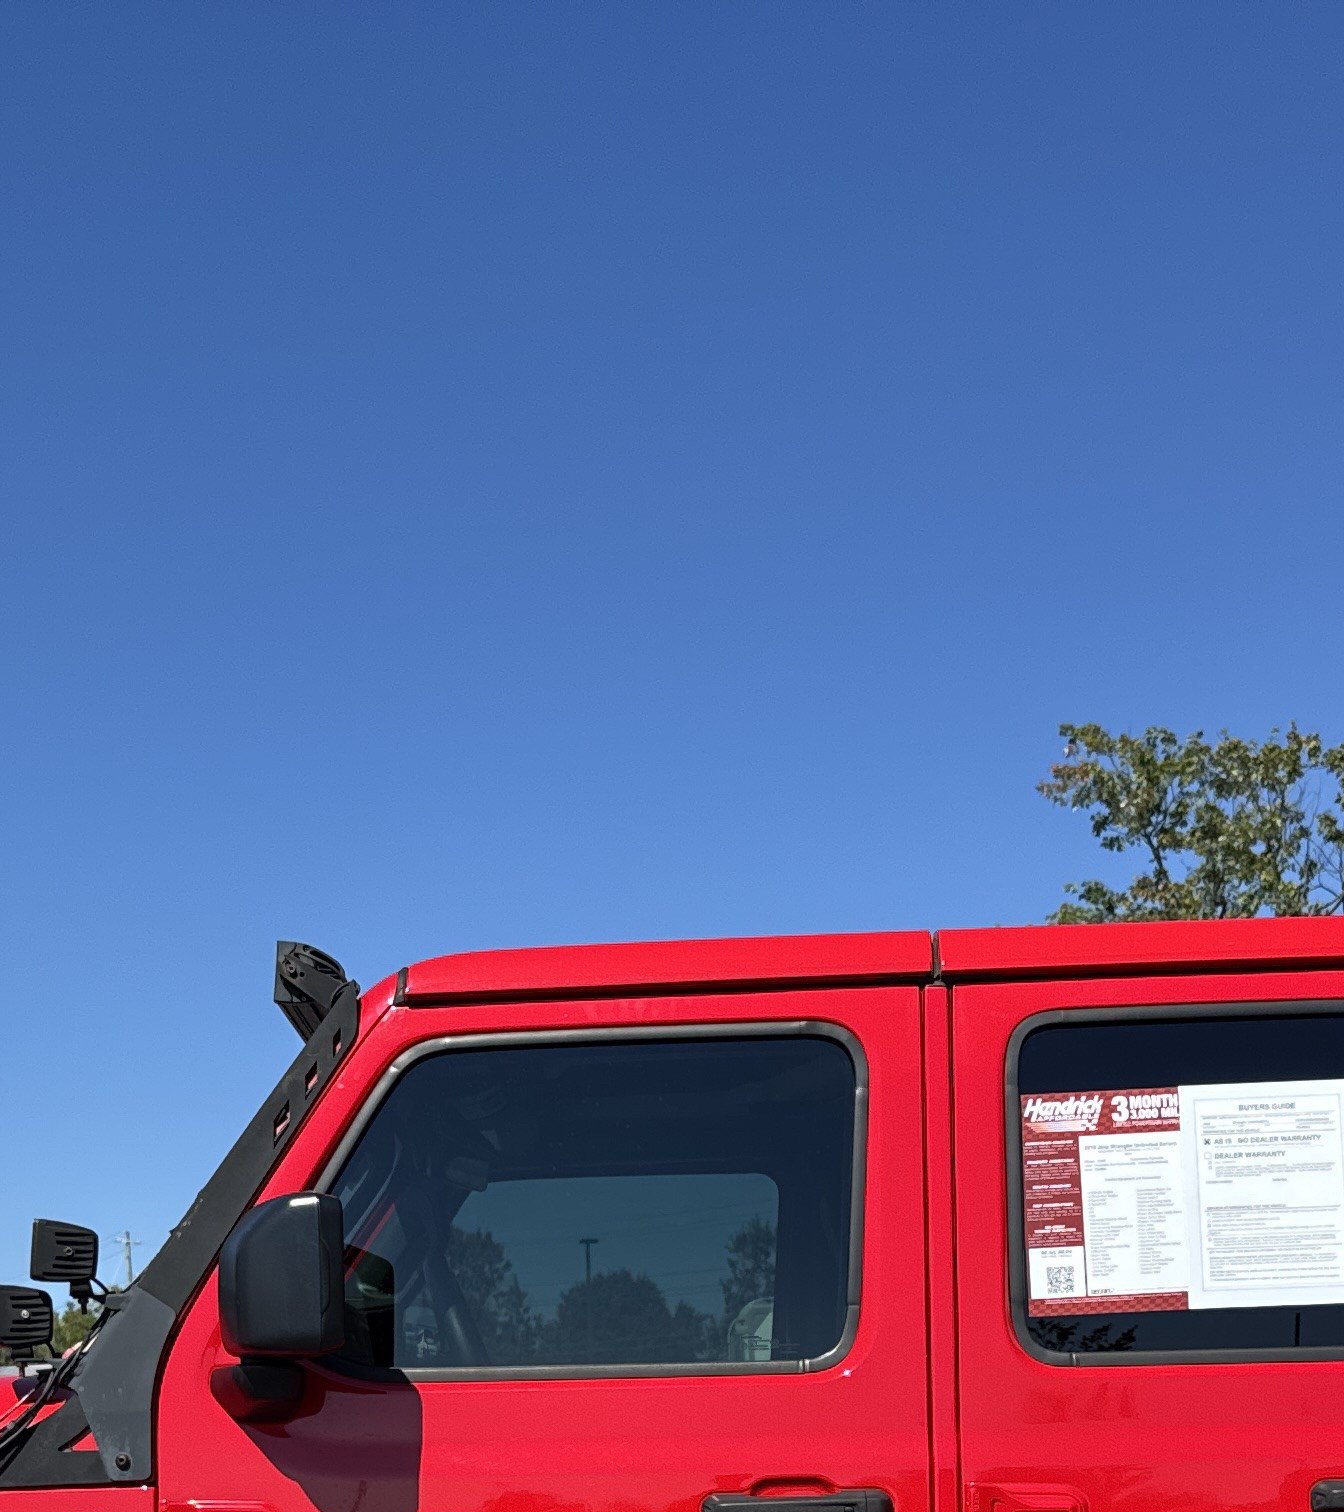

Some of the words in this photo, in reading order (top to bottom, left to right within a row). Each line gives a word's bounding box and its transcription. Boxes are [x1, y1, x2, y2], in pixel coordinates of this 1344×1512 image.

[1024, 1094, 1104, 1122] Hendrick
[1111, 1095, 1129, 1122] 3
[1238, 1103, 1270, 1111] BUYERS
[1272, 1102, 1296, 1110] GUIDE
[1161, 1107, 1180, 1118] MIL
[1281, 1134, 1321, 1142] WARRANTY
[1214, 1152, 1243, 1160] DEALER
